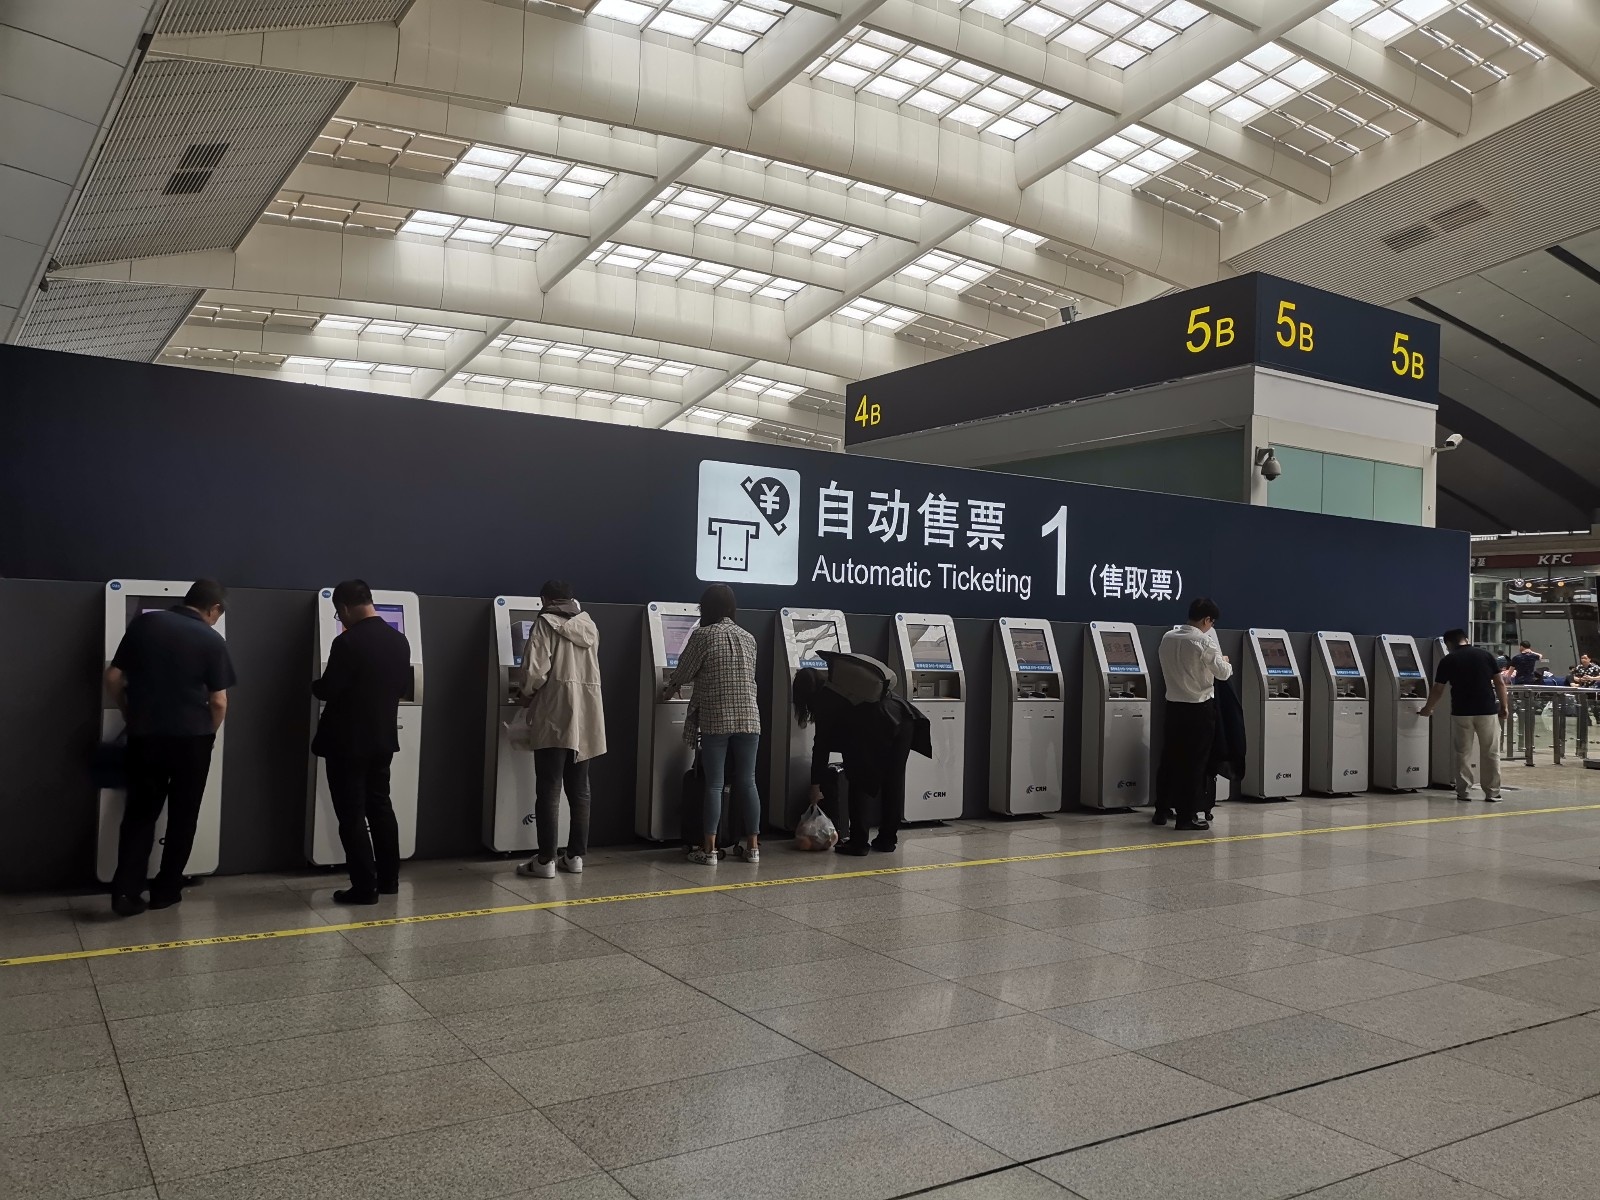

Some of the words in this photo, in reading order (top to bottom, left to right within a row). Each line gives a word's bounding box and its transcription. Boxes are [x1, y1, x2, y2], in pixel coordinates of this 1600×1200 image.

[1186, 305, 1235, 352] 5B
[1276, 301, 1314, 352] 5B
[1391, 332, 1425, 379] 5B
[854, 395, 881, 427] 4B
[817, 480, 1007, 551] 自动售票
[1041, 505, 1068, 596] 1
[1537, 554, 1573, 565] KFC
[811, 554, 932, 589] Automatic
[937, 562, 1032, 600] Ticketing
